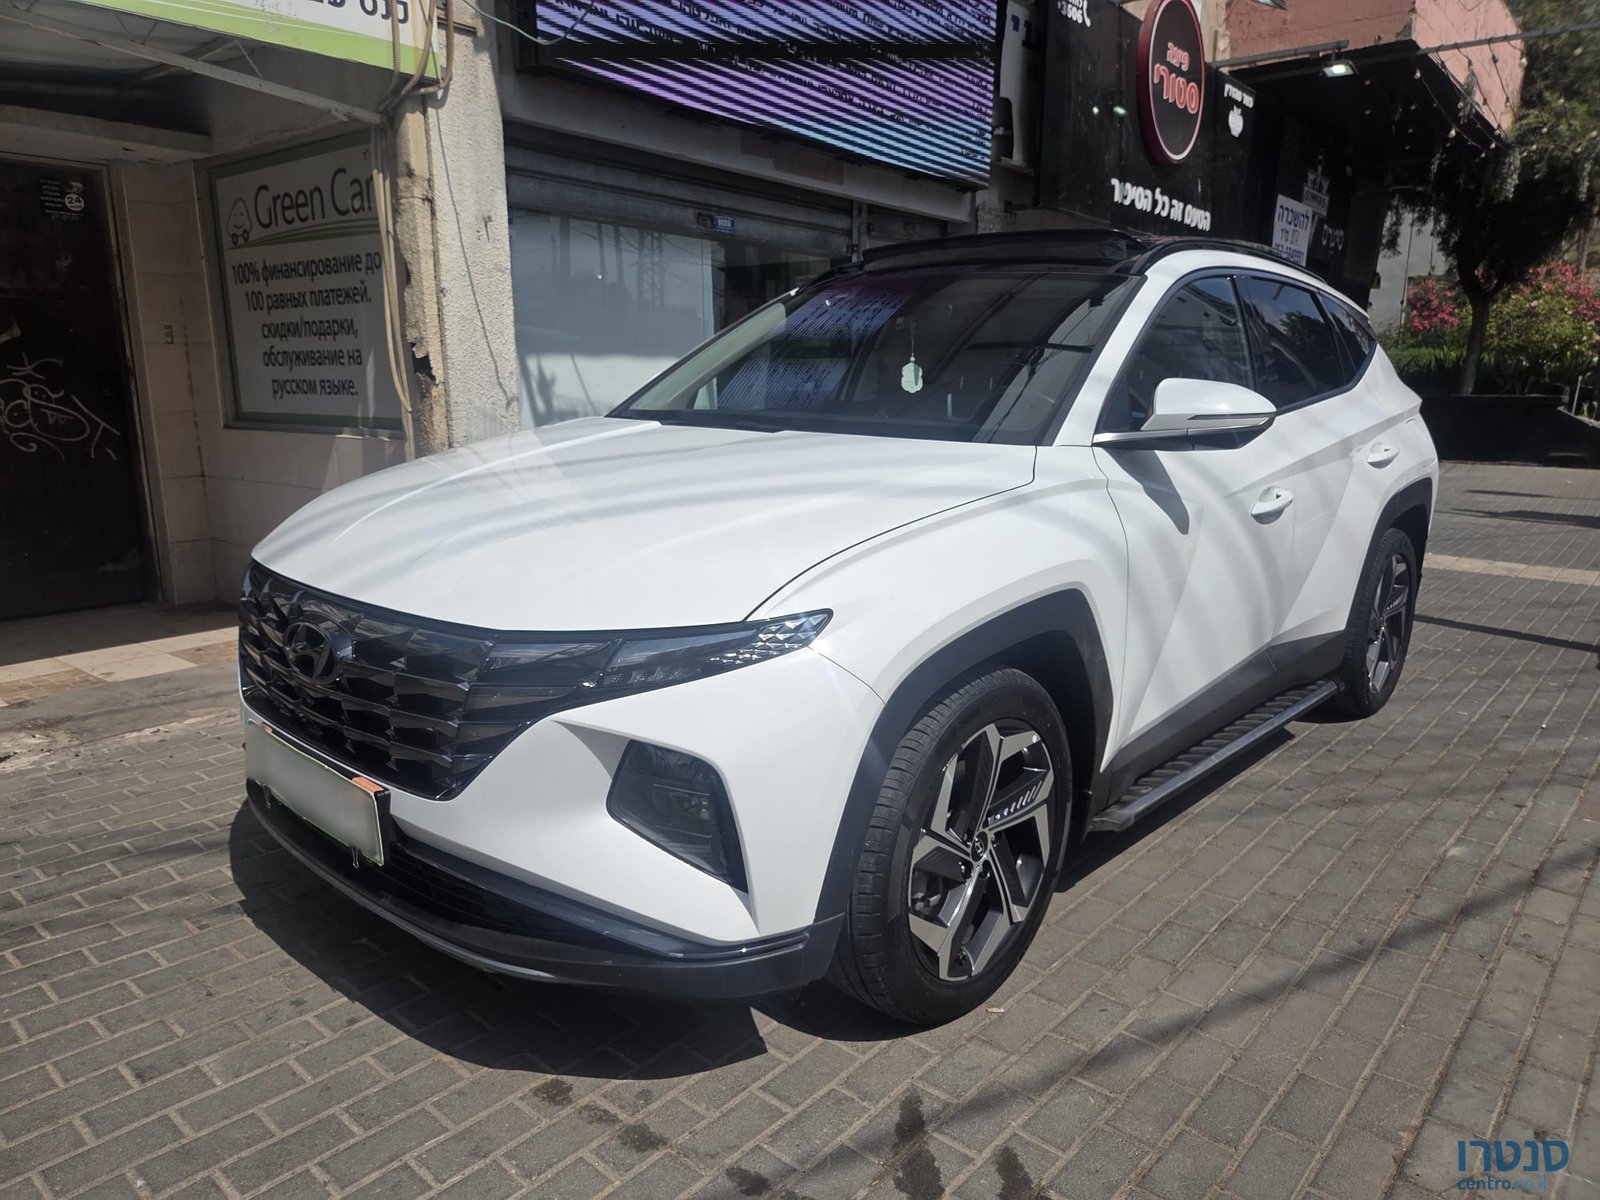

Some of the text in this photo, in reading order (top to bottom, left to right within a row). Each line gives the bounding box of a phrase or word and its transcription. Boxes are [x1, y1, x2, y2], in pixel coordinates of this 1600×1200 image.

[1153, 63, 1200, 114] סטורי
[254, 167, 375, 229] Green Car
[1110, 177, 1212, 232] הטעם זה כל הסיפור
[1277, 204, 1310, 232] להשכרה
[231, 250, 382, 288] 100% финансирование до
[244, 280, 372, 316] 100 равных платежей.
[261, 314, 359, 342] скидки/подарки,
[262, 345, 364, 372] обслуживание на
[271, 377, 359, 400] русском языке.
